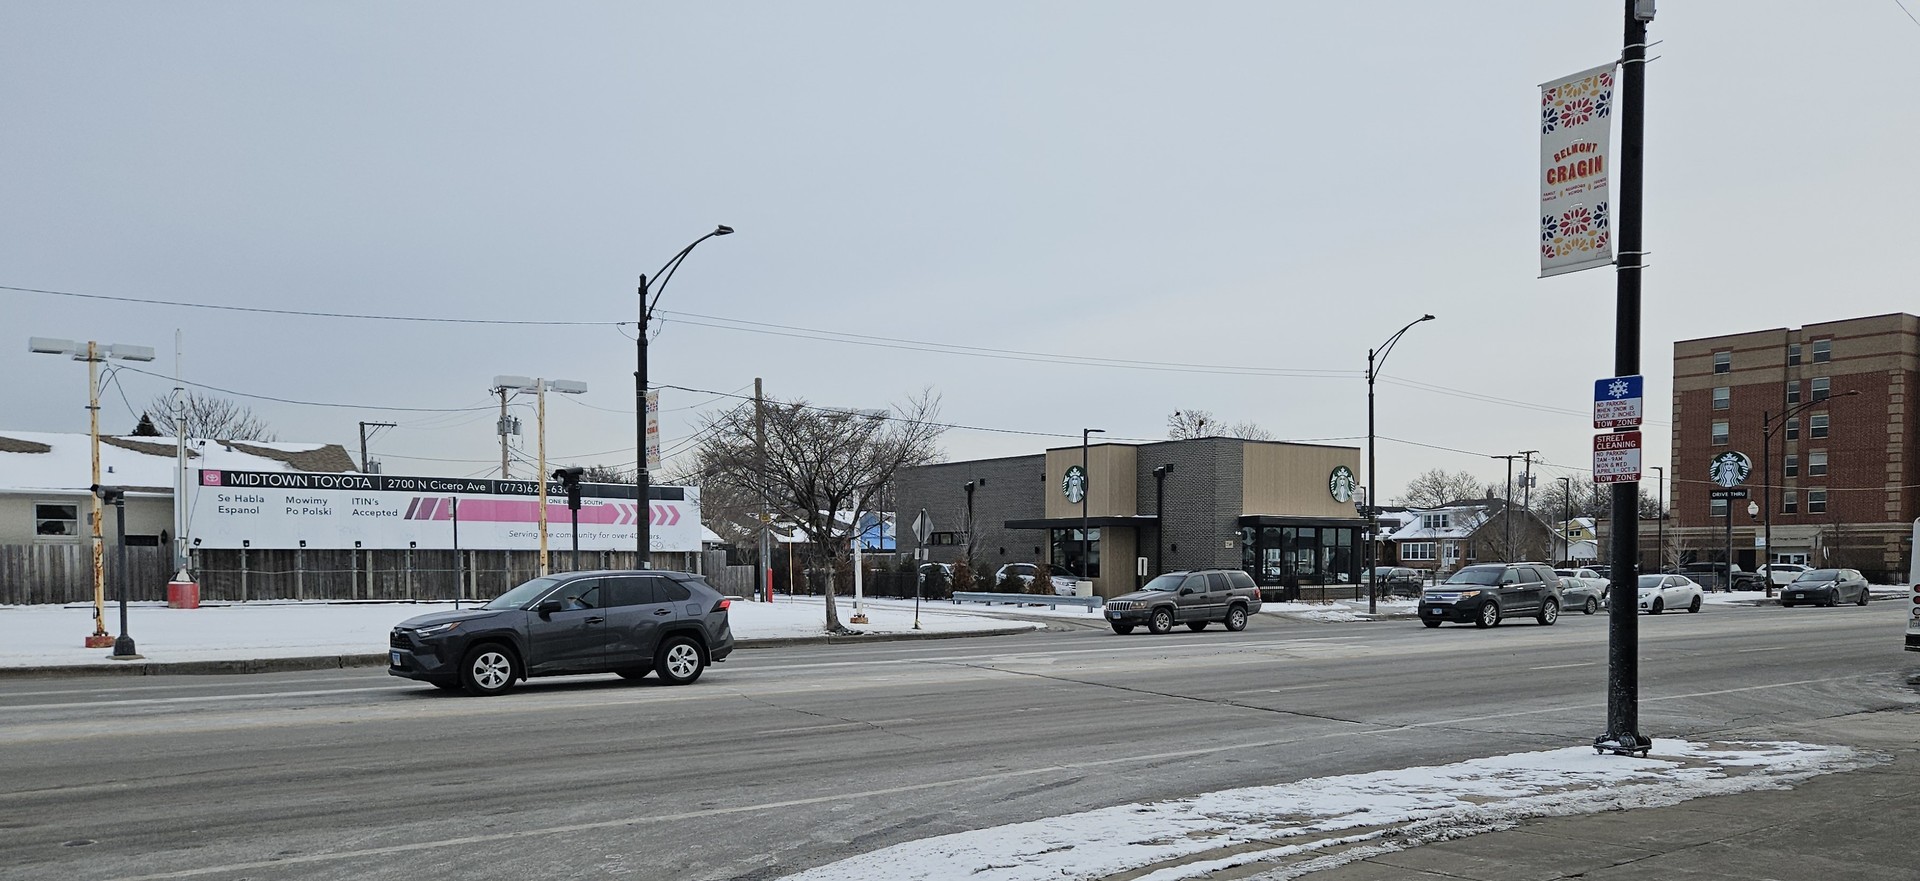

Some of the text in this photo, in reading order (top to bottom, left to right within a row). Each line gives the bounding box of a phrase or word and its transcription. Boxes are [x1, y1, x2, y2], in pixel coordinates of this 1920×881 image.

[1553, 142, 1597, 163] BELMONT
[1546, 155, 1603, 185] CRAGIN
[1597, 418, 1638, 428] TOW ZONE
[1597, 434, 1625, 443] STREET
[1596, 440, 1636, 450] CLEANING
[230, 473, 308, 487] MIDTOWN
[312, 475, 372, 488] TOYOTA
[388, 479, 415, 488] 2700
[418, 480, 427, 489] N
[430, 480, 464, 490] Cicero
[467, 482, 486, 491] Ave
[1616, 473, 1638, 481] ZONE
[218, 494, 265, 503] Se Habla
[286, 496, 328, 506] Mowimy
[352, 497, 379, 505] ITIN's
[218, 505, 259, 515] Espanol
[286, 507, 332, 515] Po Polski
[352, 508, 398, 518] Accepted
[509, 530, 538, 539] Serving
[556, 532, 597, 540] comunity
[599, 531, 610, 539] for
